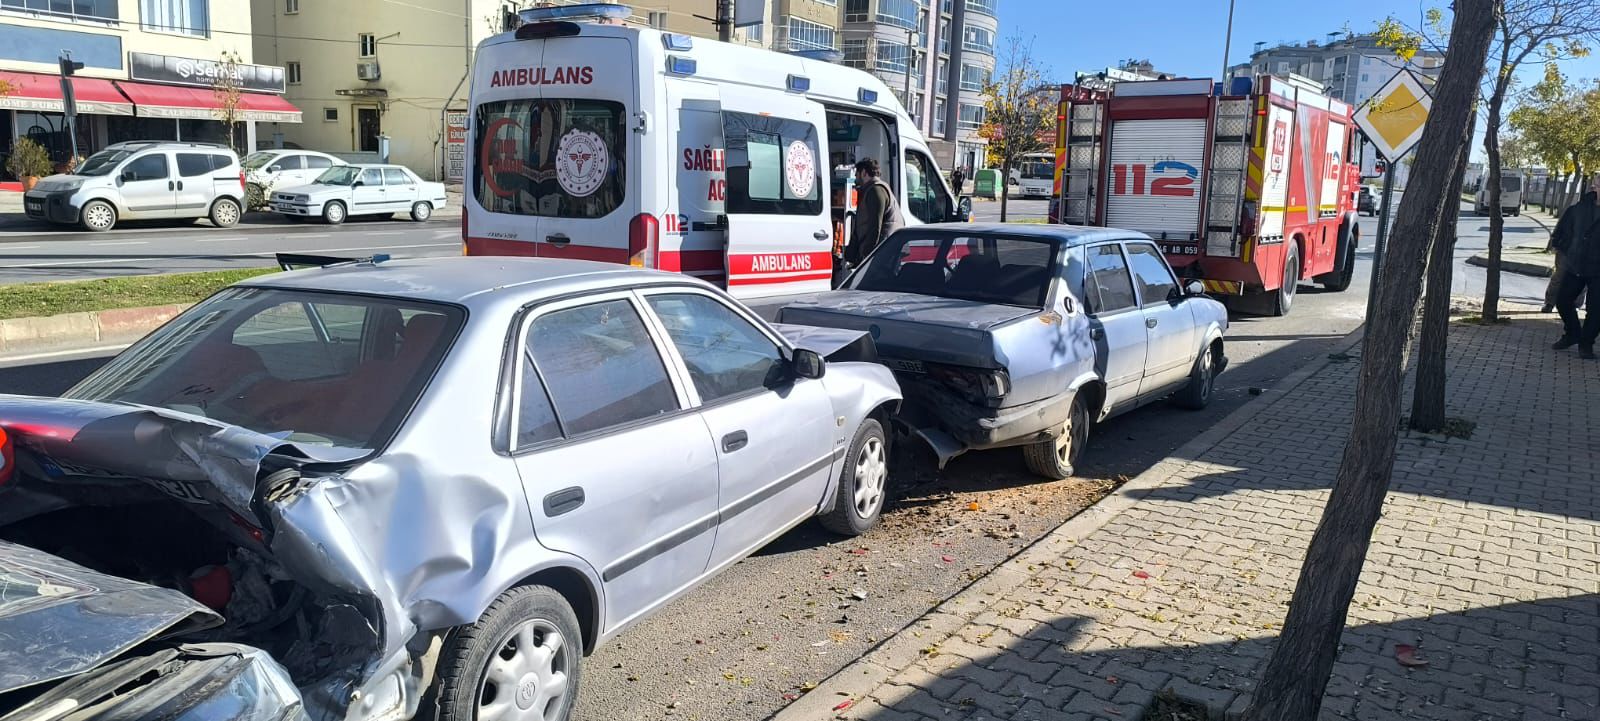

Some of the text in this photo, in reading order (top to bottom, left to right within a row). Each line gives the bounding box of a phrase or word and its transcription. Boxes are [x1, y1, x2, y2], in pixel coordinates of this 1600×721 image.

[490, 66, 594, 88] AMBULANS
[1323, 150, 1341, 180] 112
[1113, 161, 1198, 197] 112
[665, 213, 689, 232] 112
[1184, 246, 1198, 255] 059
[751, 255, 812, 272] AMBULANS
